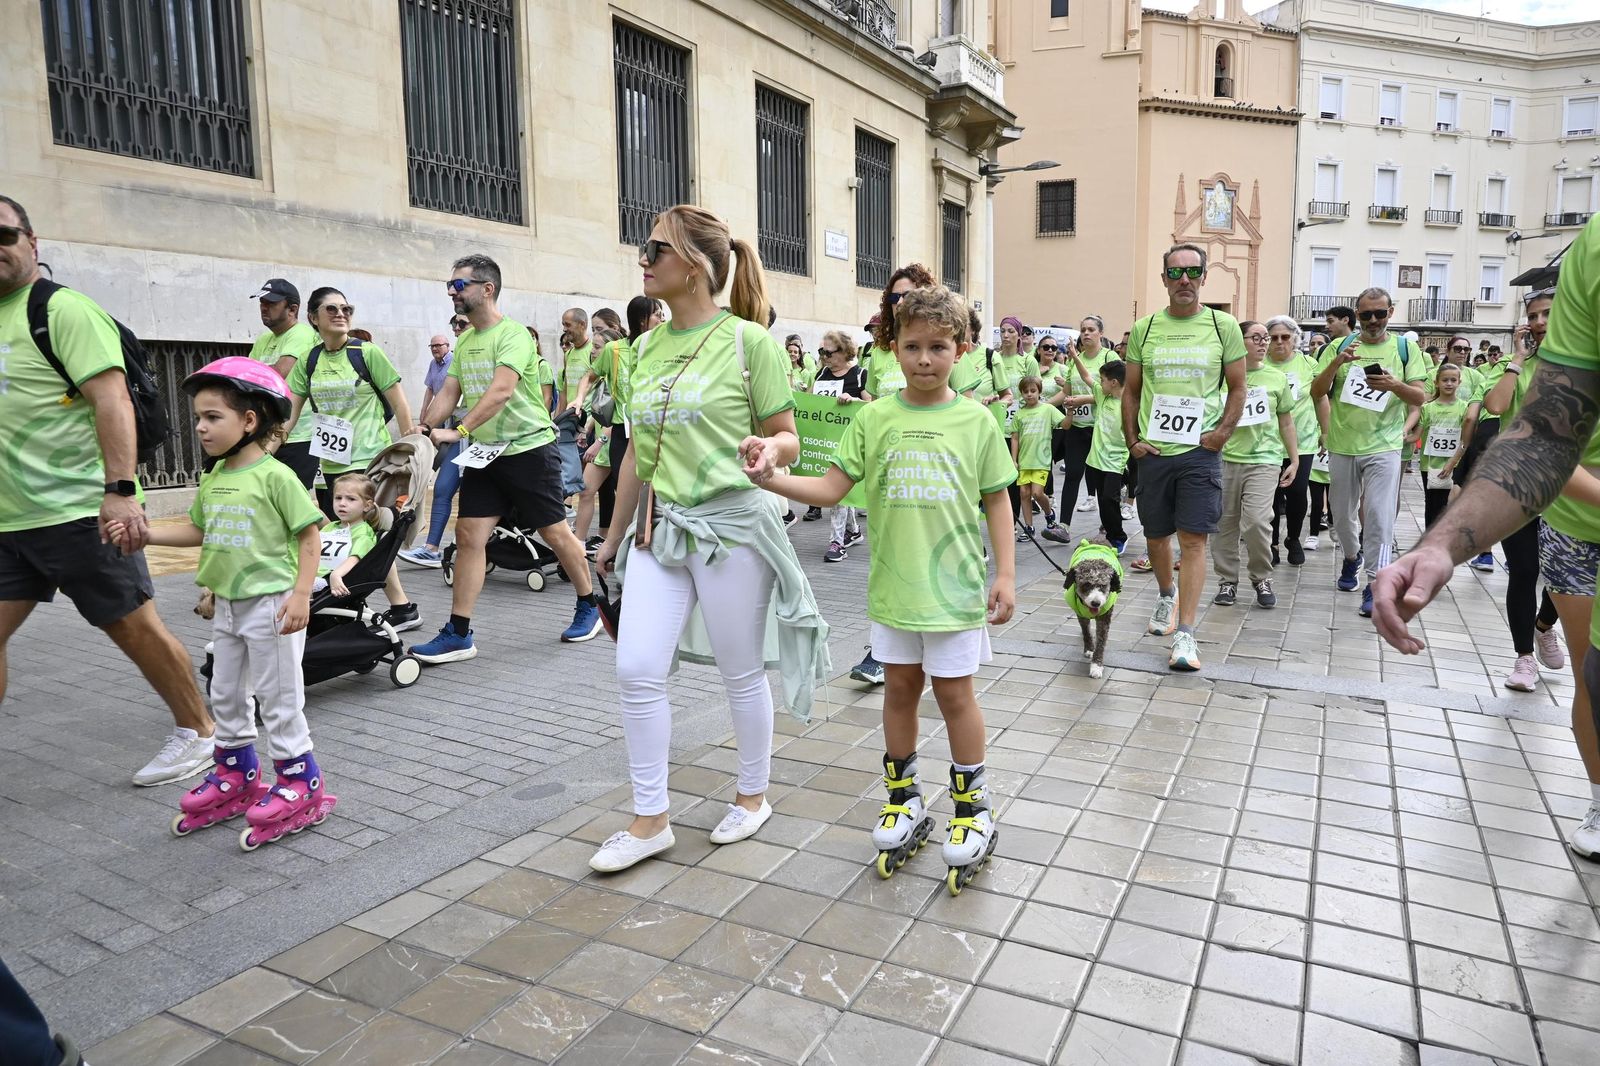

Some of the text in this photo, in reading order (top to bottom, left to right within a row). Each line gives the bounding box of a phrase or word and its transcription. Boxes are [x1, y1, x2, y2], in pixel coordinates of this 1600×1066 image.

[1154, 365, 1207, 379] cáncer
[631, 390, 704, 403] conta el
[794, 407, 851, 426] tra el Cán
[801, 462, 813, 472] en
[887, 464, 940, 481] contra
[887, 480, 959, 502] cáncer
